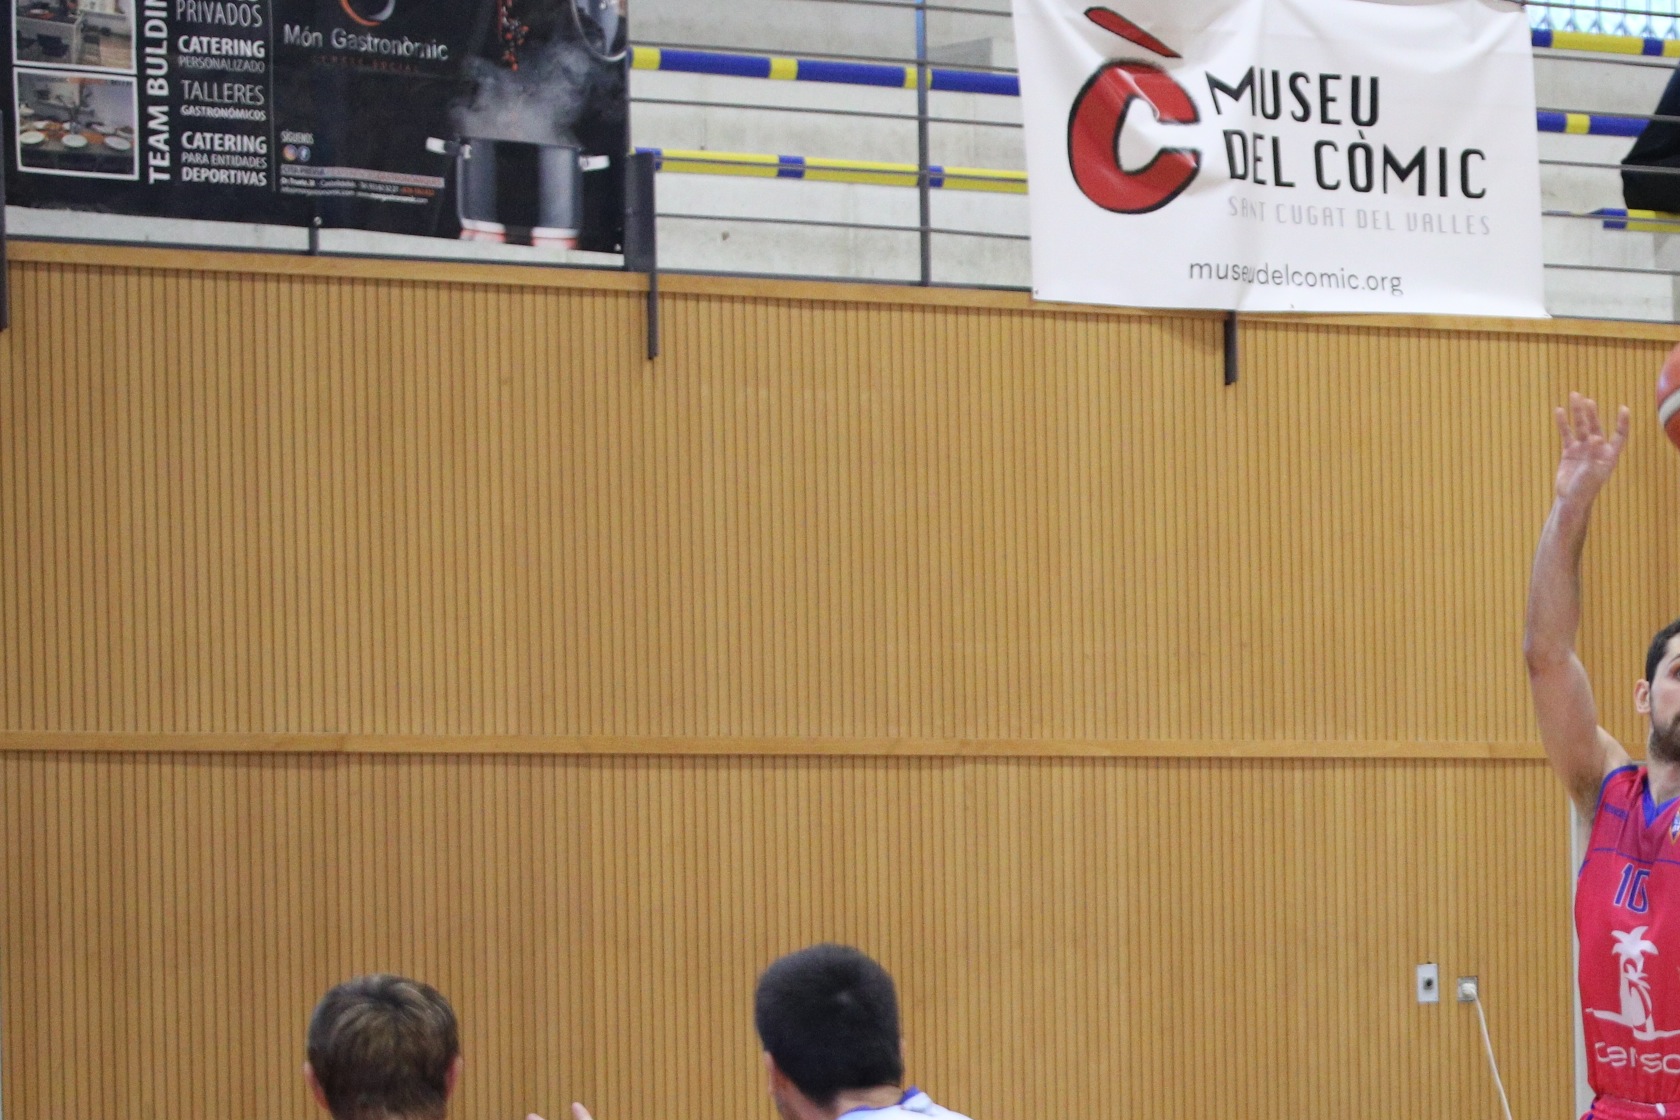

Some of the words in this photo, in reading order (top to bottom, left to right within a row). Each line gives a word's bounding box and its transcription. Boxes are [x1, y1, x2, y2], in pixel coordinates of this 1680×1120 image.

[175, 0, 263, 28] PRIVADOS
[177, 35, 265, 58] CATERING
[283, 23, 323, 47] Món
[178, 56, 266, 74] PERSONALIZADO
[180, 79, 265, 106] TALLERES
[1205, 66, 1380, 127] MUSEU
[147, 105, 171, 185] TEAM
[181, 131, 267, 154] CATERING
[181, 153, 209, 165] PARA
[211, 154, 267, 169] ENTIDADES
[1223, 129, 1296, 188] DEL
[1314, 129, 1487, 199] CÒMIC
[181, 167, 267, 186] DEPORTIVAS
[1228, 196, 1266, 222] SANT
[1276, 203, 1346, 228] CUGAT
[1357, 208, 1396, 231] DEL
[1188, 259, 1404, 296] museudelcomic.org
